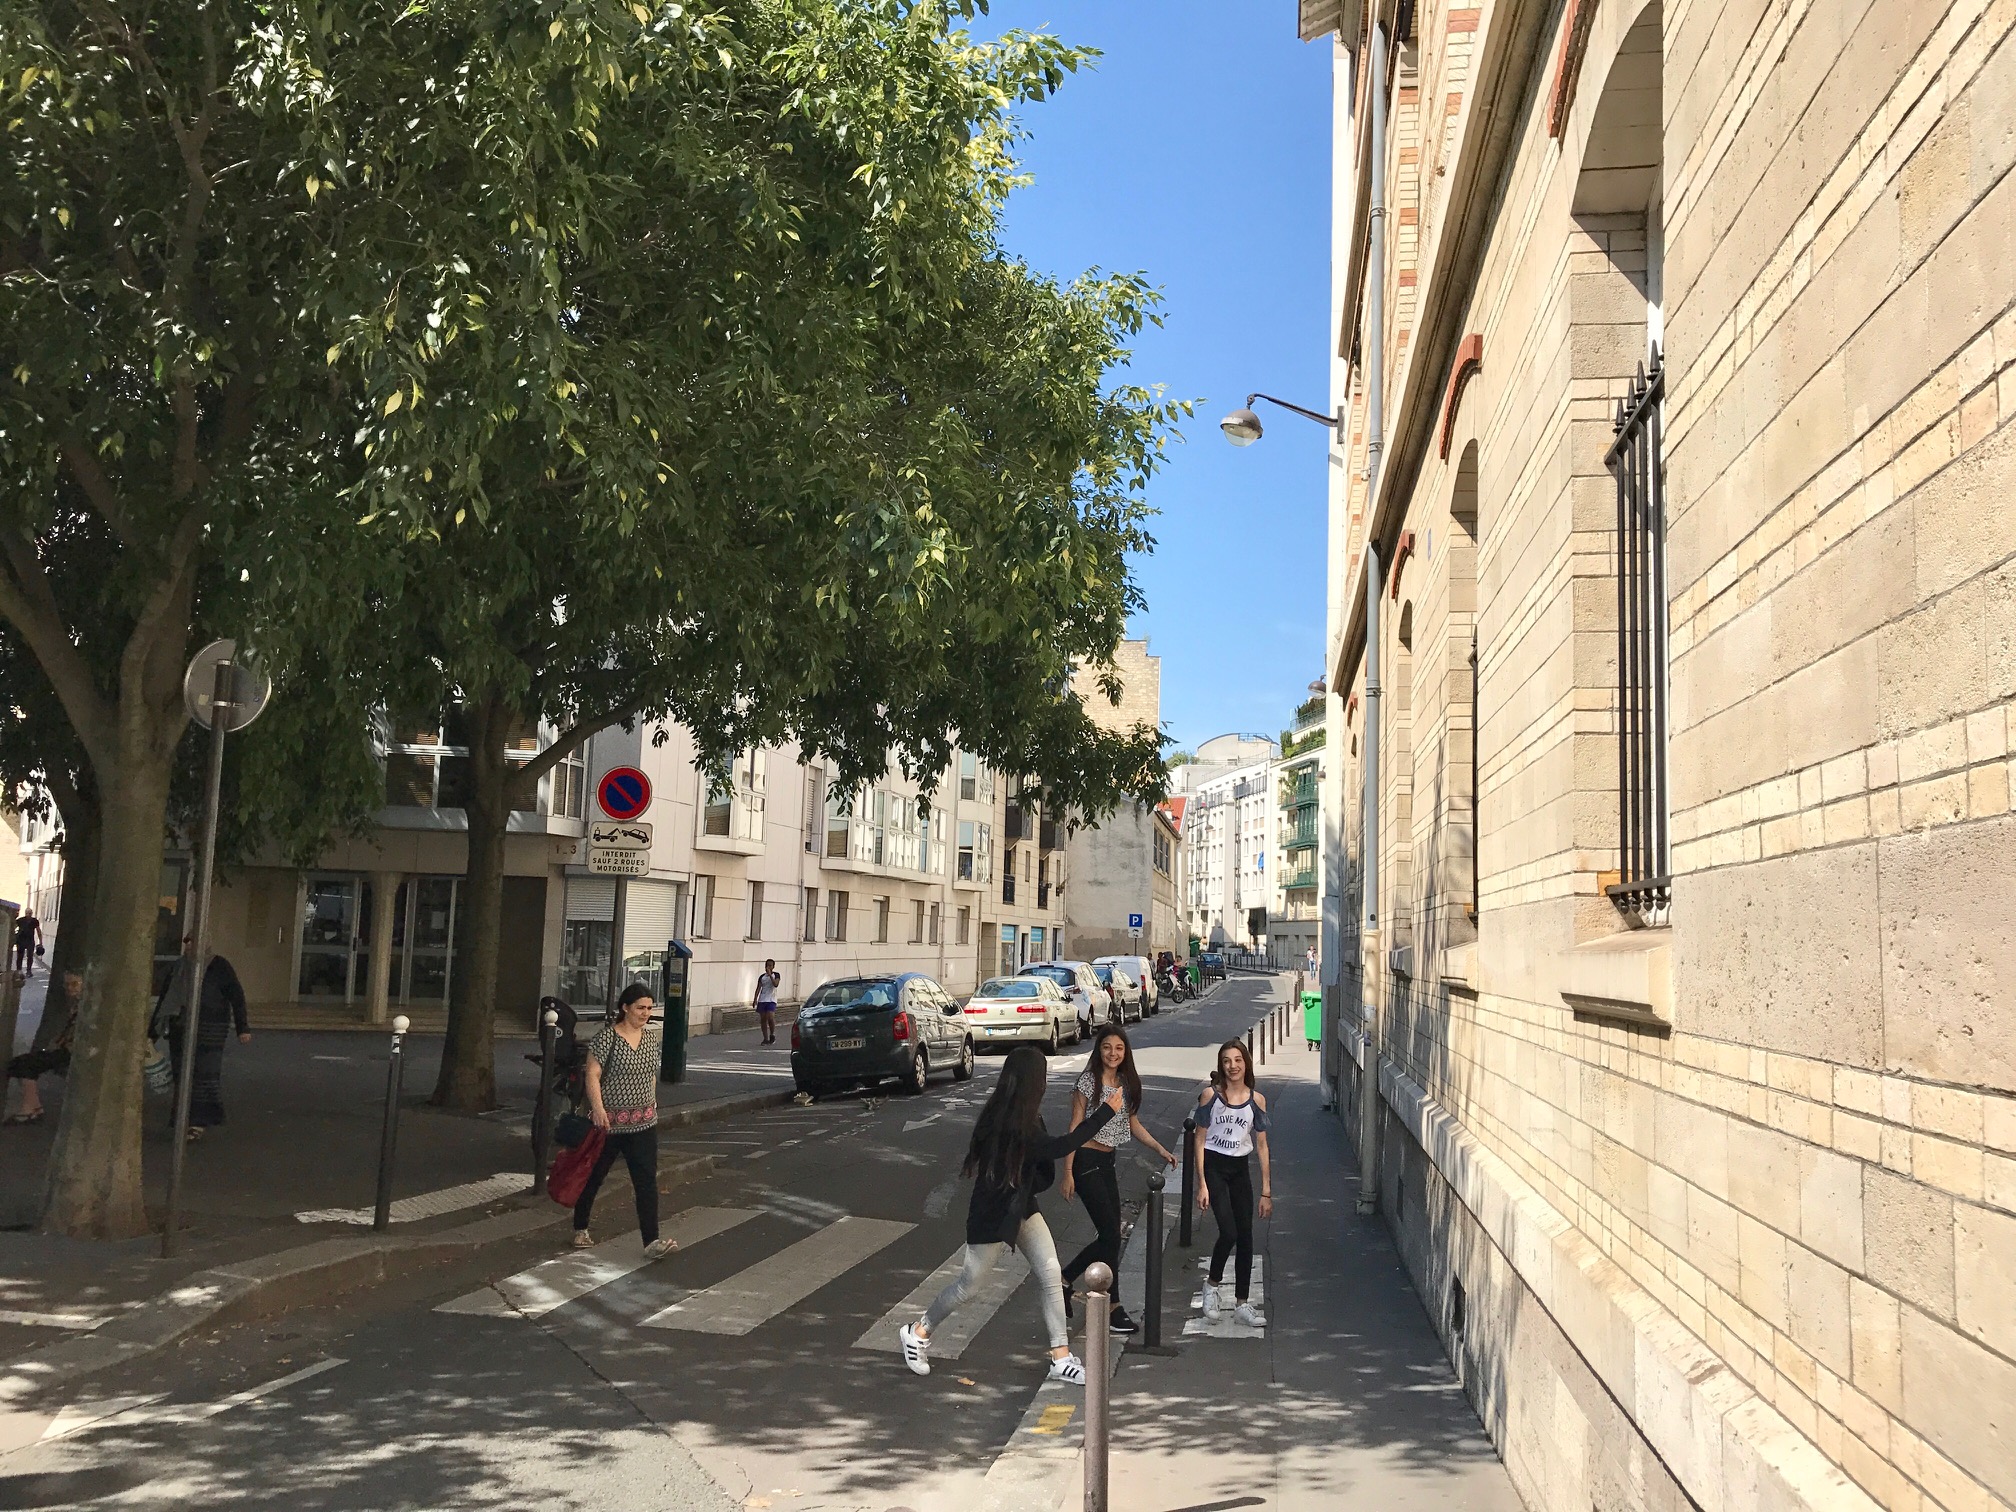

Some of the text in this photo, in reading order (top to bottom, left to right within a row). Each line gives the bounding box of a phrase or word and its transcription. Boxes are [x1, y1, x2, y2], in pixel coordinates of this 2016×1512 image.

[597, 865, 640, 873] MOTORISÉS
[1132, 916, 1140, 926] P
[1215, 1115, 1248, 1129] LOVE ME
